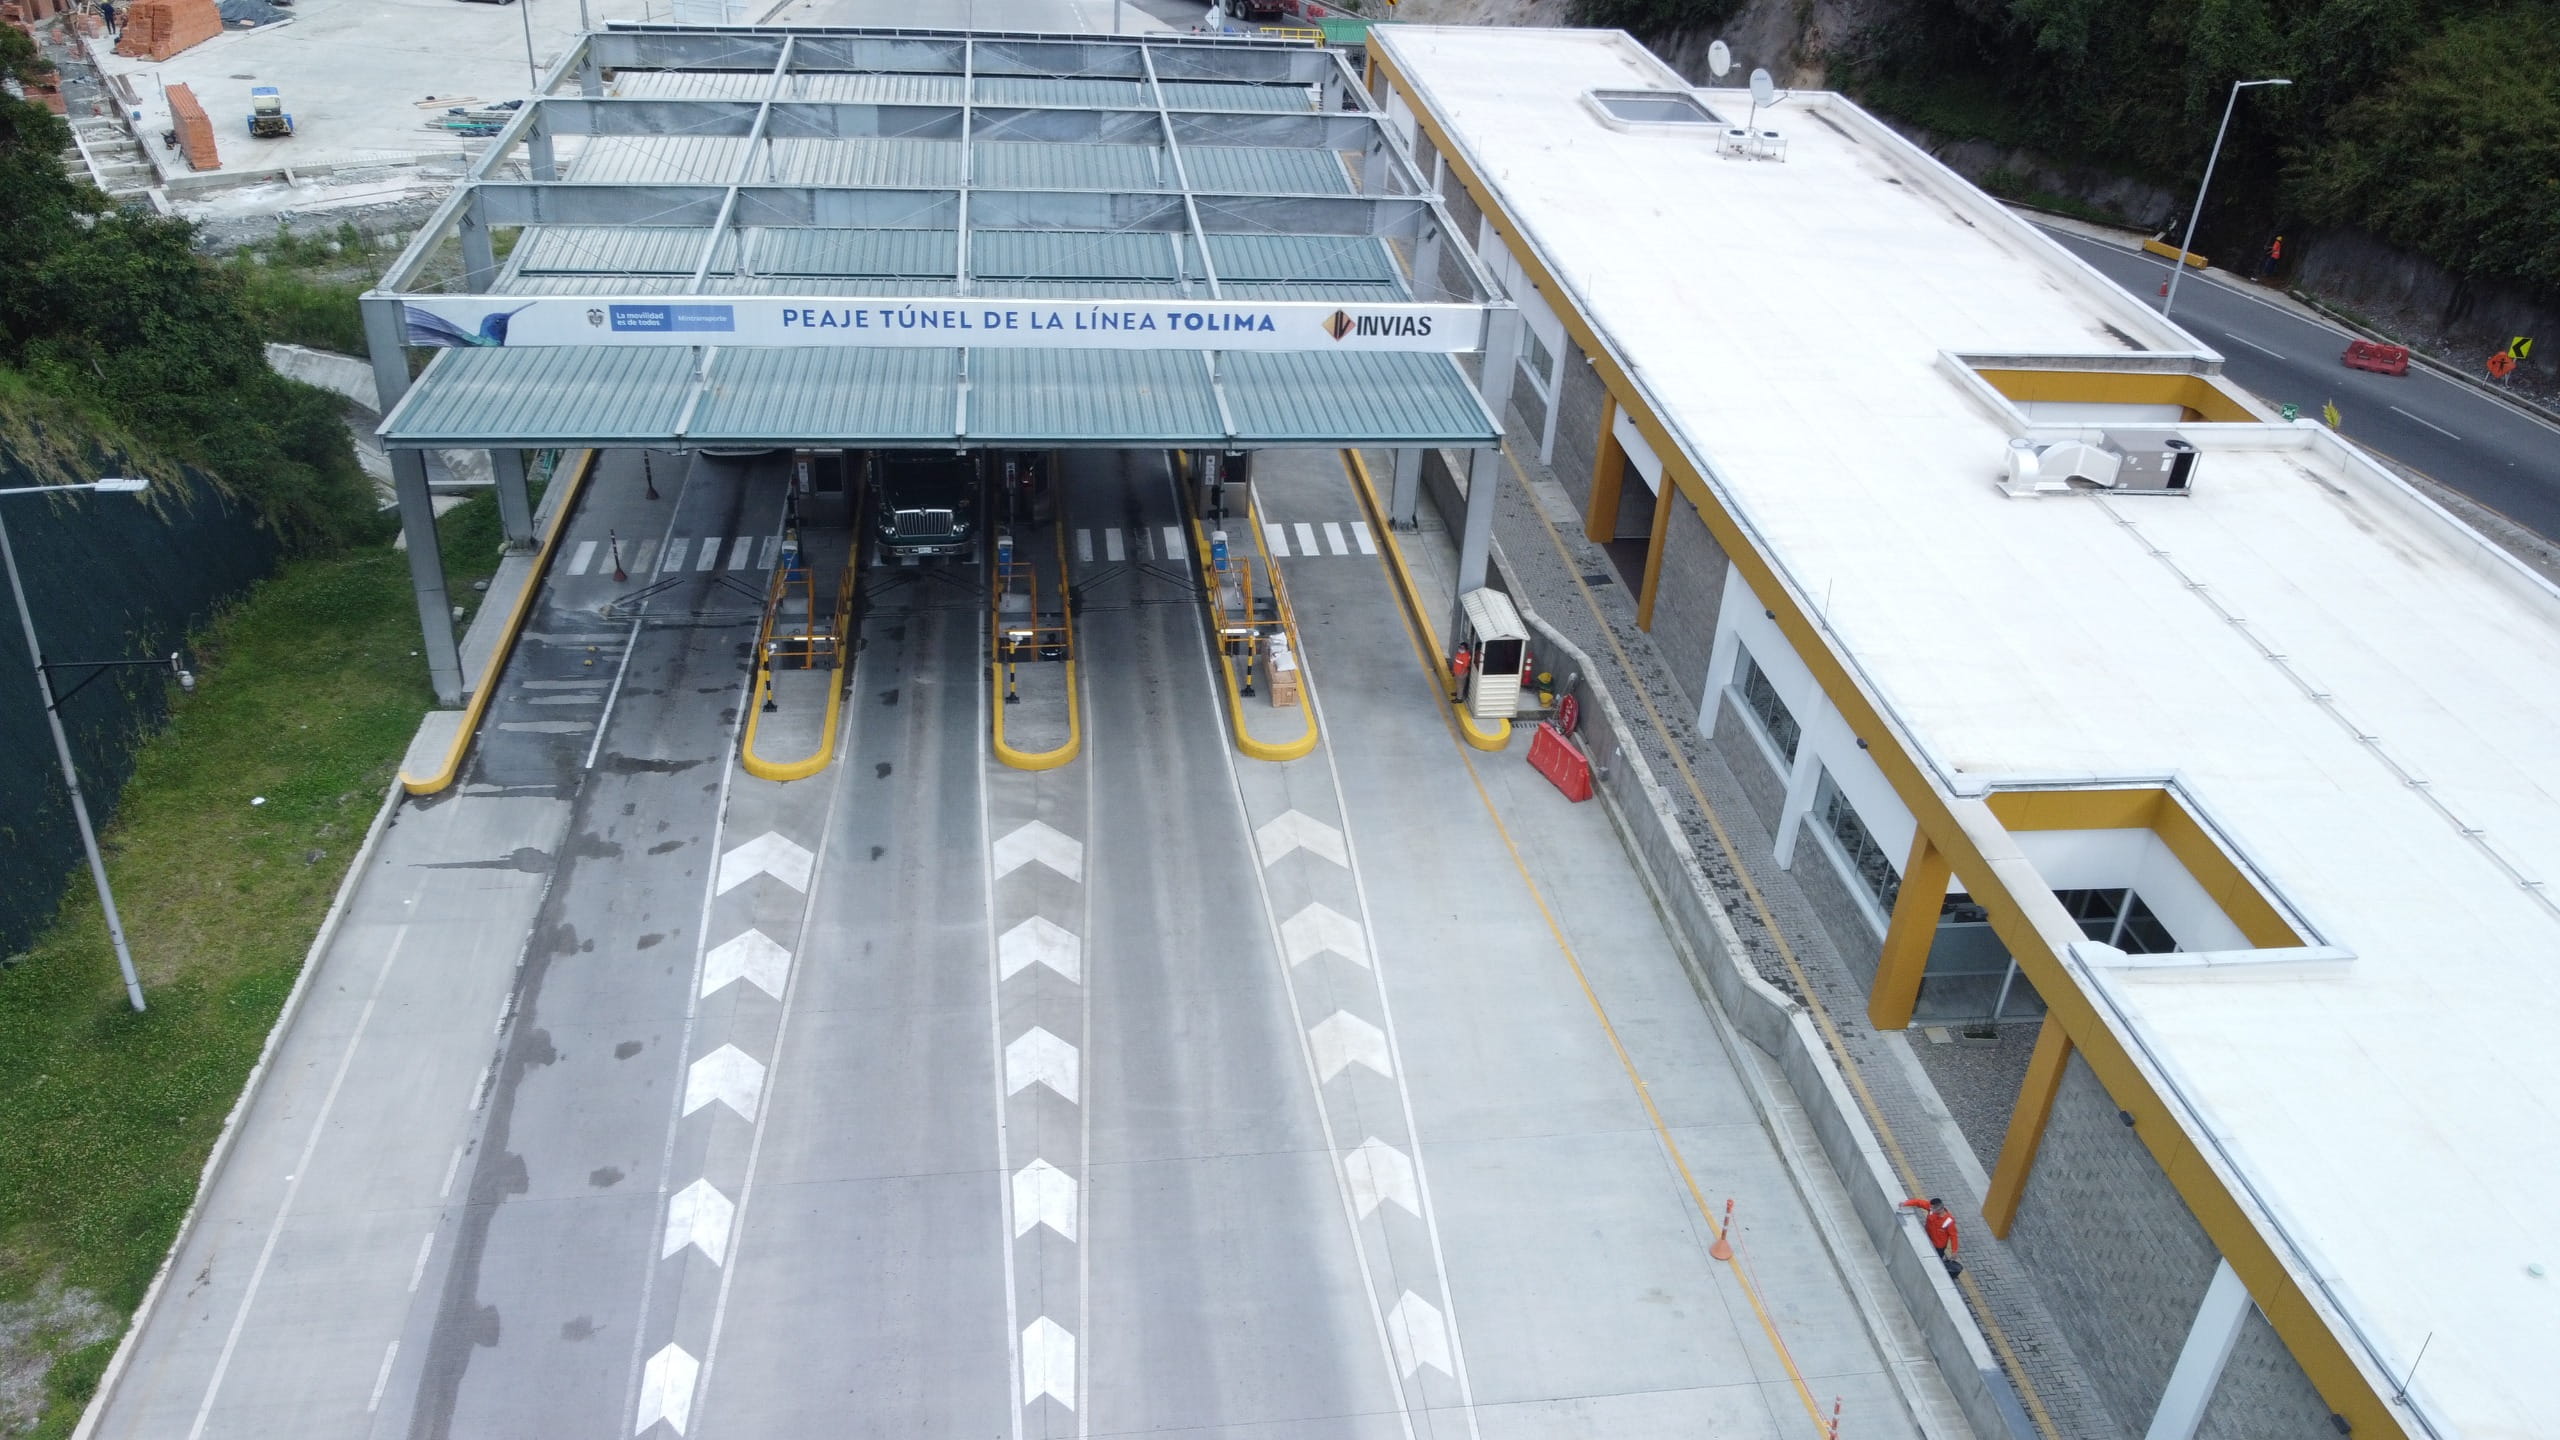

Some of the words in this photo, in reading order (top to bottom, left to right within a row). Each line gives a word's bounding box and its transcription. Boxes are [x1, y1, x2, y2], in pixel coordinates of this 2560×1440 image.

[627, 312, 664, 320] movilidad
[783, 309, 868, 328] PEAJE
[880, 304, 972, 329] TÚNEL
[984, 312, 1018, 329] DE
[1031, 311, 1064, 330] LA
[1075, 306, 1156, 330] LÍNEA
[1167, 313, 1276, 331] TOLIMA
[1356, 316, 1432, 336] INVIAS
